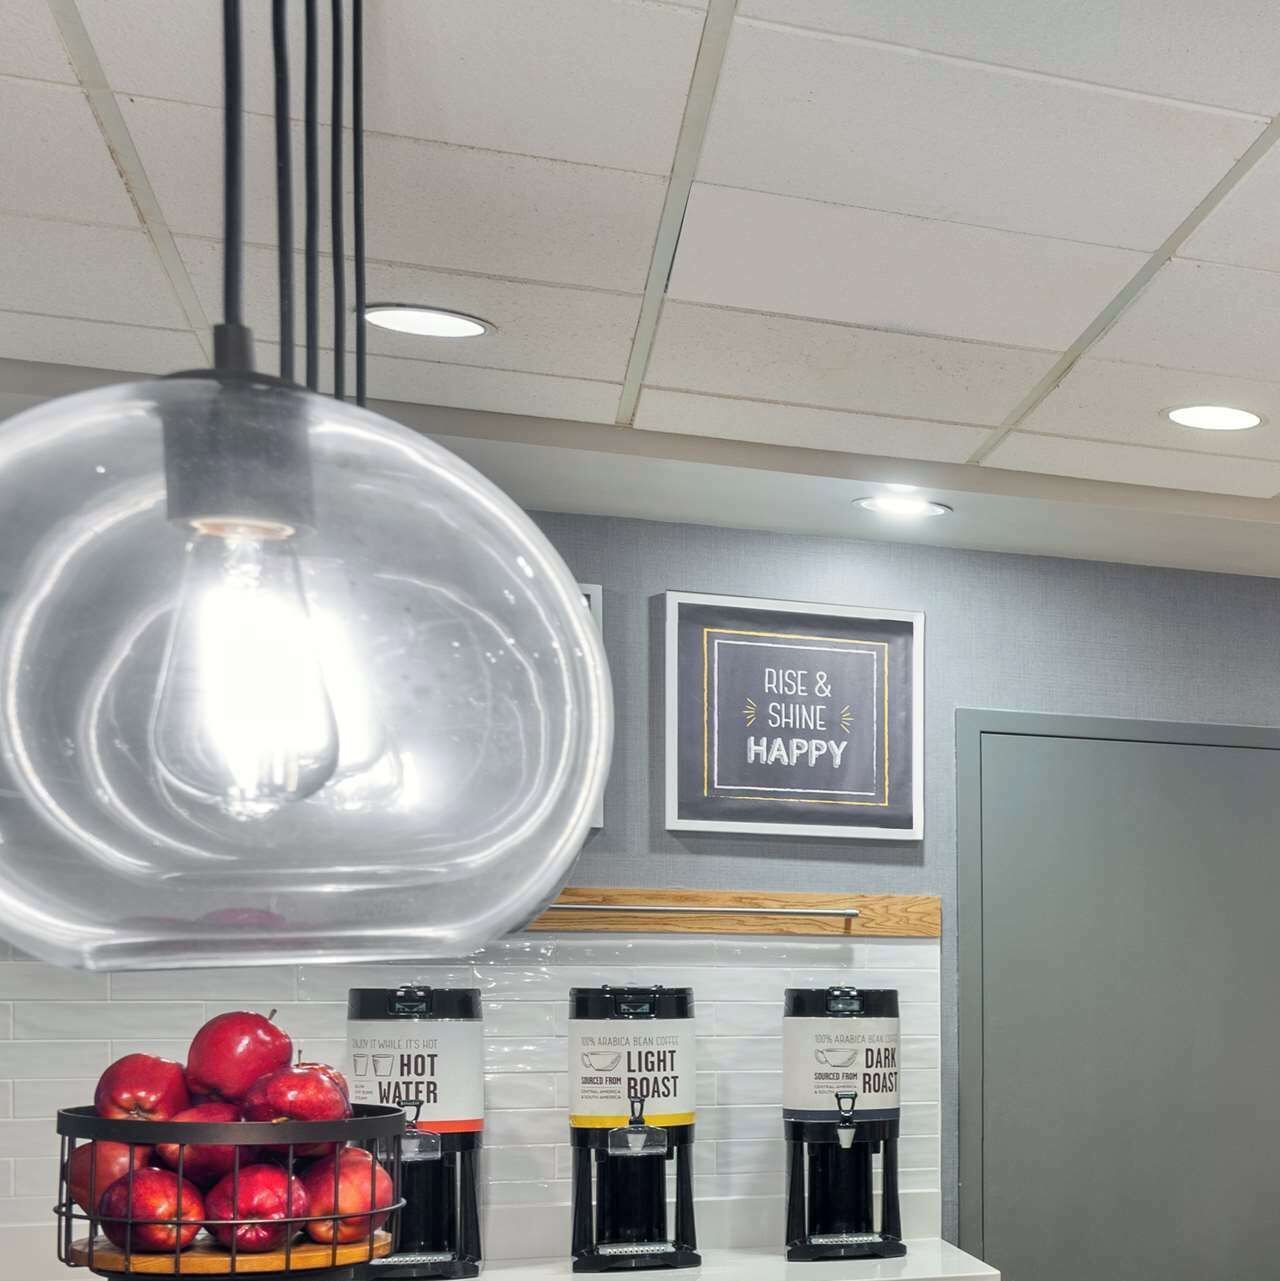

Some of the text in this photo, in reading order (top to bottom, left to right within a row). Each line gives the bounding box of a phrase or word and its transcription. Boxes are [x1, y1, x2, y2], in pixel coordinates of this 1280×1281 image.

[764, 668, 832, 697] RISE &
[768, 702, 827, 731] SHINE
[747, 736, 848, 768] HAPPY
[400, 1053, 438, 1076] HOT
[626, 1050, 677, 1073] LIGHT
[865, 1048, 897, 1069] DARK
[605, 1076, 622, 1085] FROM
[627, 1076, 679, 1098] ROAST
[814, 1072, 858, 1081] SOURCED FROM
[862, 1072, 898, 1093] ROAST
[378, 1081, 438, 1104] WATER
